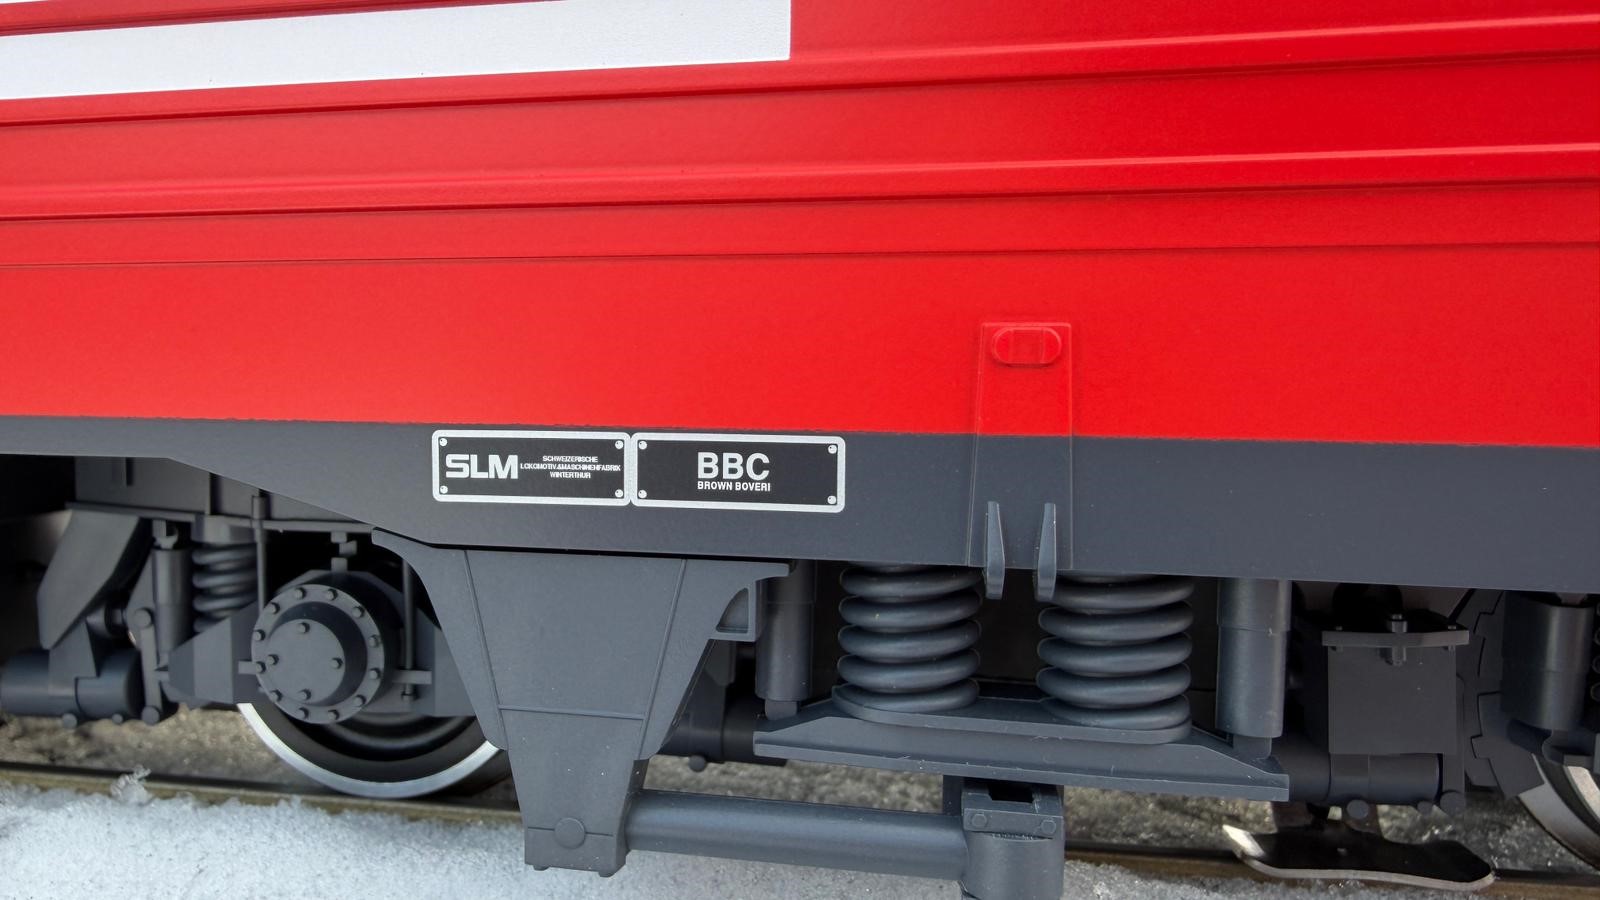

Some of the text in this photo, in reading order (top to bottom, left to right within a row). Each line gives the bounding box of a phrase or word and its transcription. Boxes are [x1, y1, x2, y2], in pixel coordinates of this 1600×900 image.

[542, 455, 598, 463] SCHWEIZERISCHE
[445, 453, 519, 480] SLM
[697, 451, 770, 481] BBC
[549, 471, 591, 479] WINTERTHUR
[697, 481, 771, 492] BROWN BOVERI
